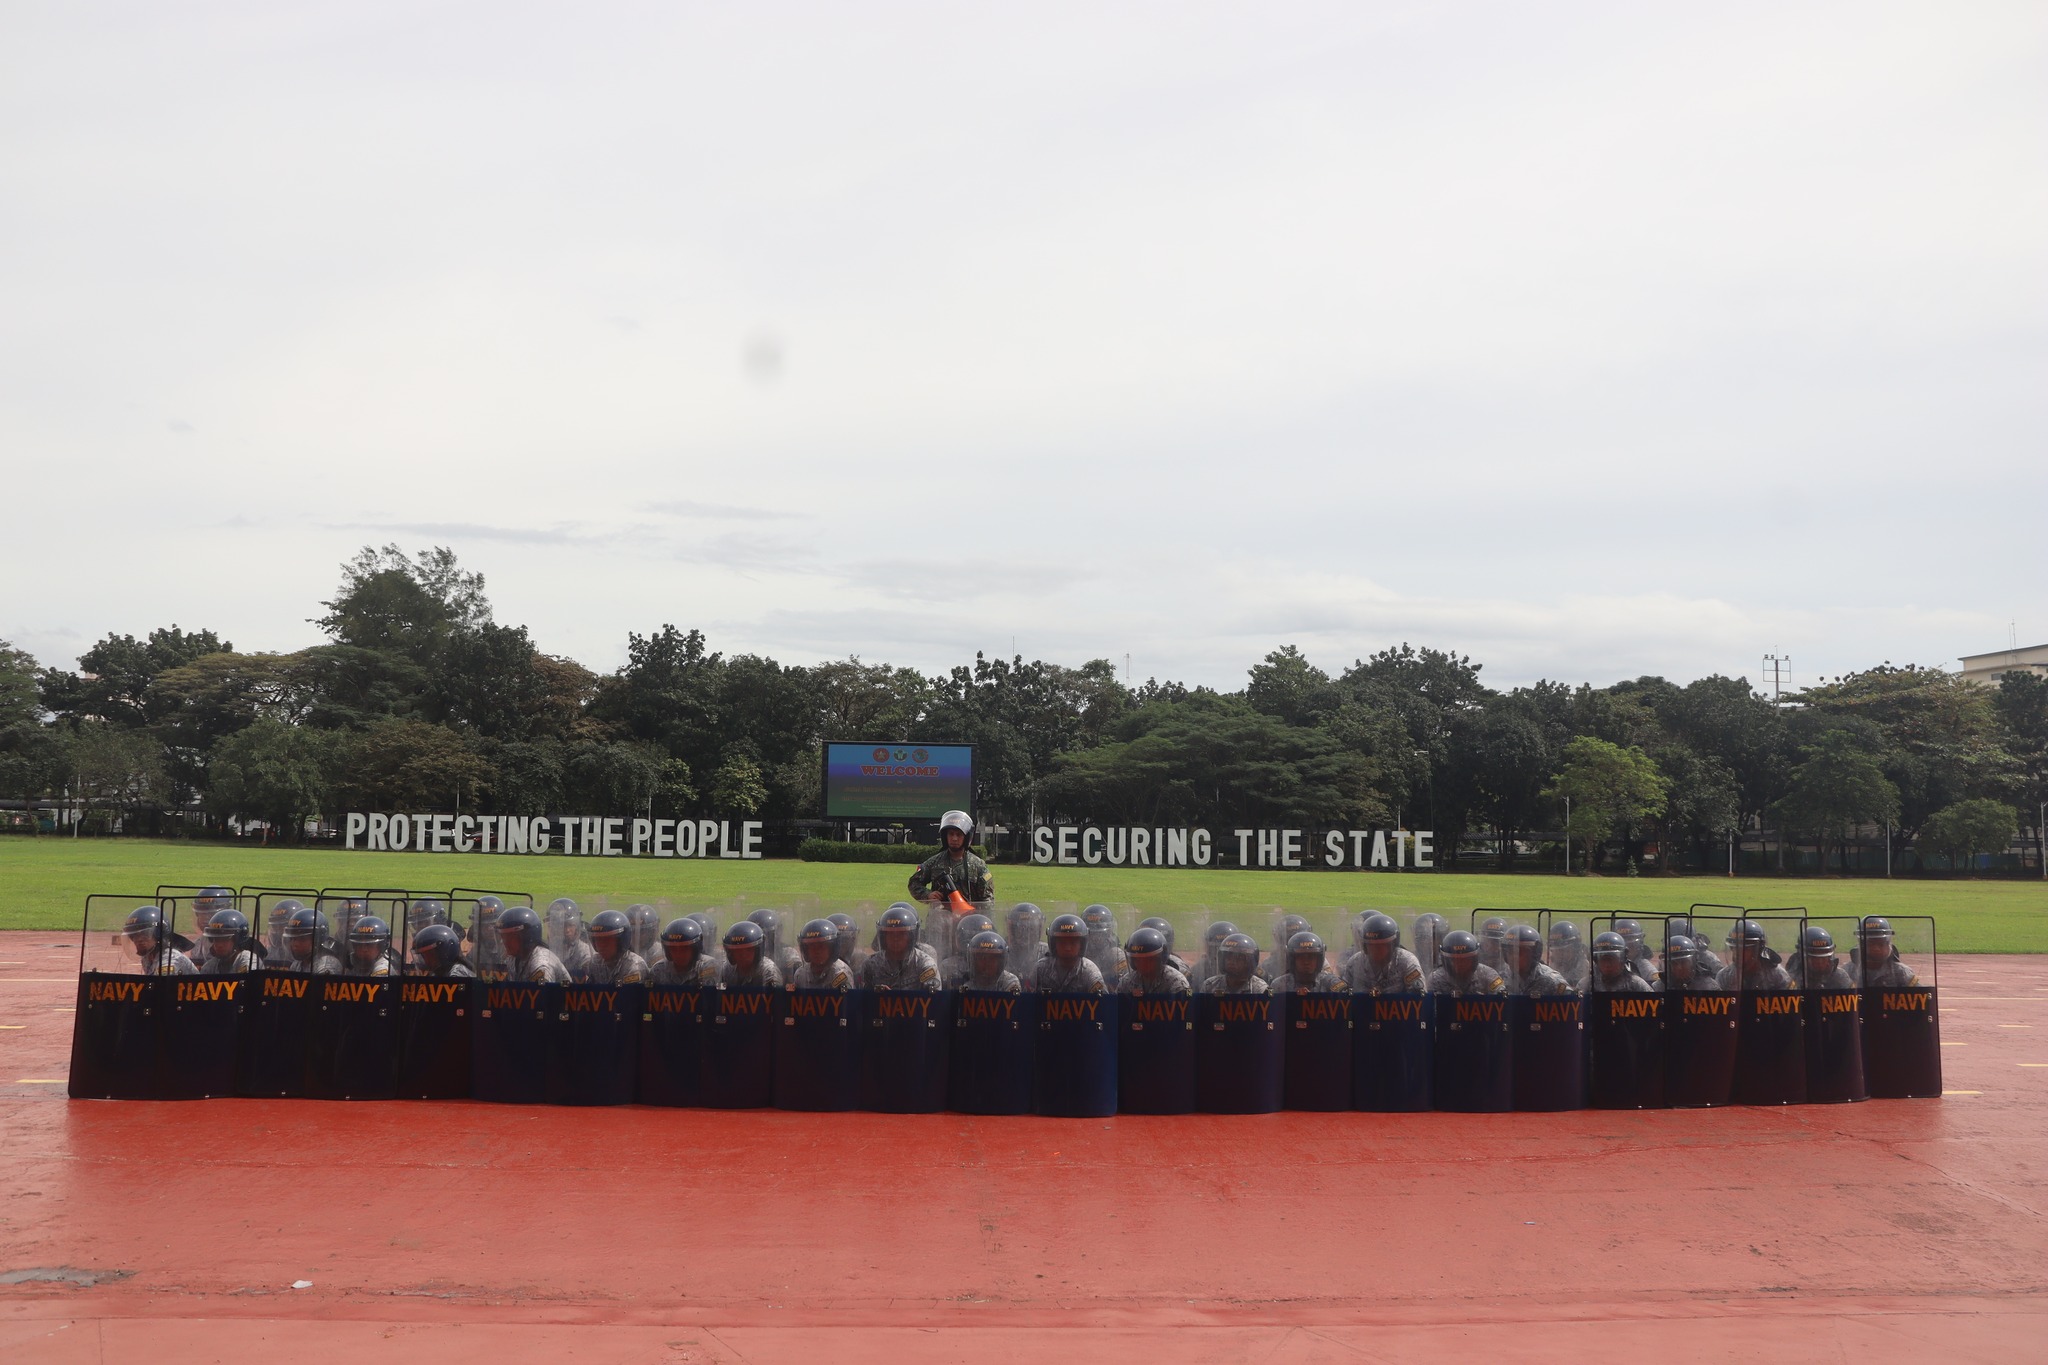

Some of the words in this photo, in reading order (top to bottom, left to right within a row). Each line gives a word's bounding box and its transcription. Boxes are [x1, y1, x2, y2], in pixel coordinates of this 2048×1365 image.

[860, 765, 940, 777] WELCOME
[345, 812, 550, 854] PROTECTING
[559, 817, 624, 855] THE
[632, 818, 763, 859] PEOPLE
[1034, 826, 1211, 866] SECURING
[1234, 829, 1302, 867] THE
[1325, 829, 1434, 867] STATE
[358, 926, 374, 934] NAVY
[89, 981, 144, 1002] NAVY
[177, 981, 239, 1001] NAVY
[263, 977, 309, 998] NAV
[324, 982, 380, 1002] NAVY
[402, 983, 458, 1003] NAVY
[487, 988, 541, 1010] NAVY
[564, 991, 618, 1012] NAVY
[649, 991, 700, 1013] NAVY
[721, 992, 773, 1015] NAVY
[791, 995, 843, 1017] NAVY
[879, 996, 932, 1018] NAVY
[962, 997, 1016, 1020] NAVY
[1611, 999, 1660, 1018] NAVY
[1683, 996, 1731, 1015] NAVY
[1756, 996, 1801, 1014] NAVY
[1821, 994, 1859, 1013] NAVY
[1883, 993, 1928, 1011] NAVY
[1046, 999, 1099, 1021] NAVY
[1138, 1000, 1189, 1021] NAVY
[1219, 1001, 1270, 1022] NAVY
[1302, 1000, 1350, 1020] NAVY
[1375, 1000, 1423, 1021] NAVY
[1456, 1001, 1505, 1022] NAVY
[1535, 1001, 1581, 1022] NAVY
